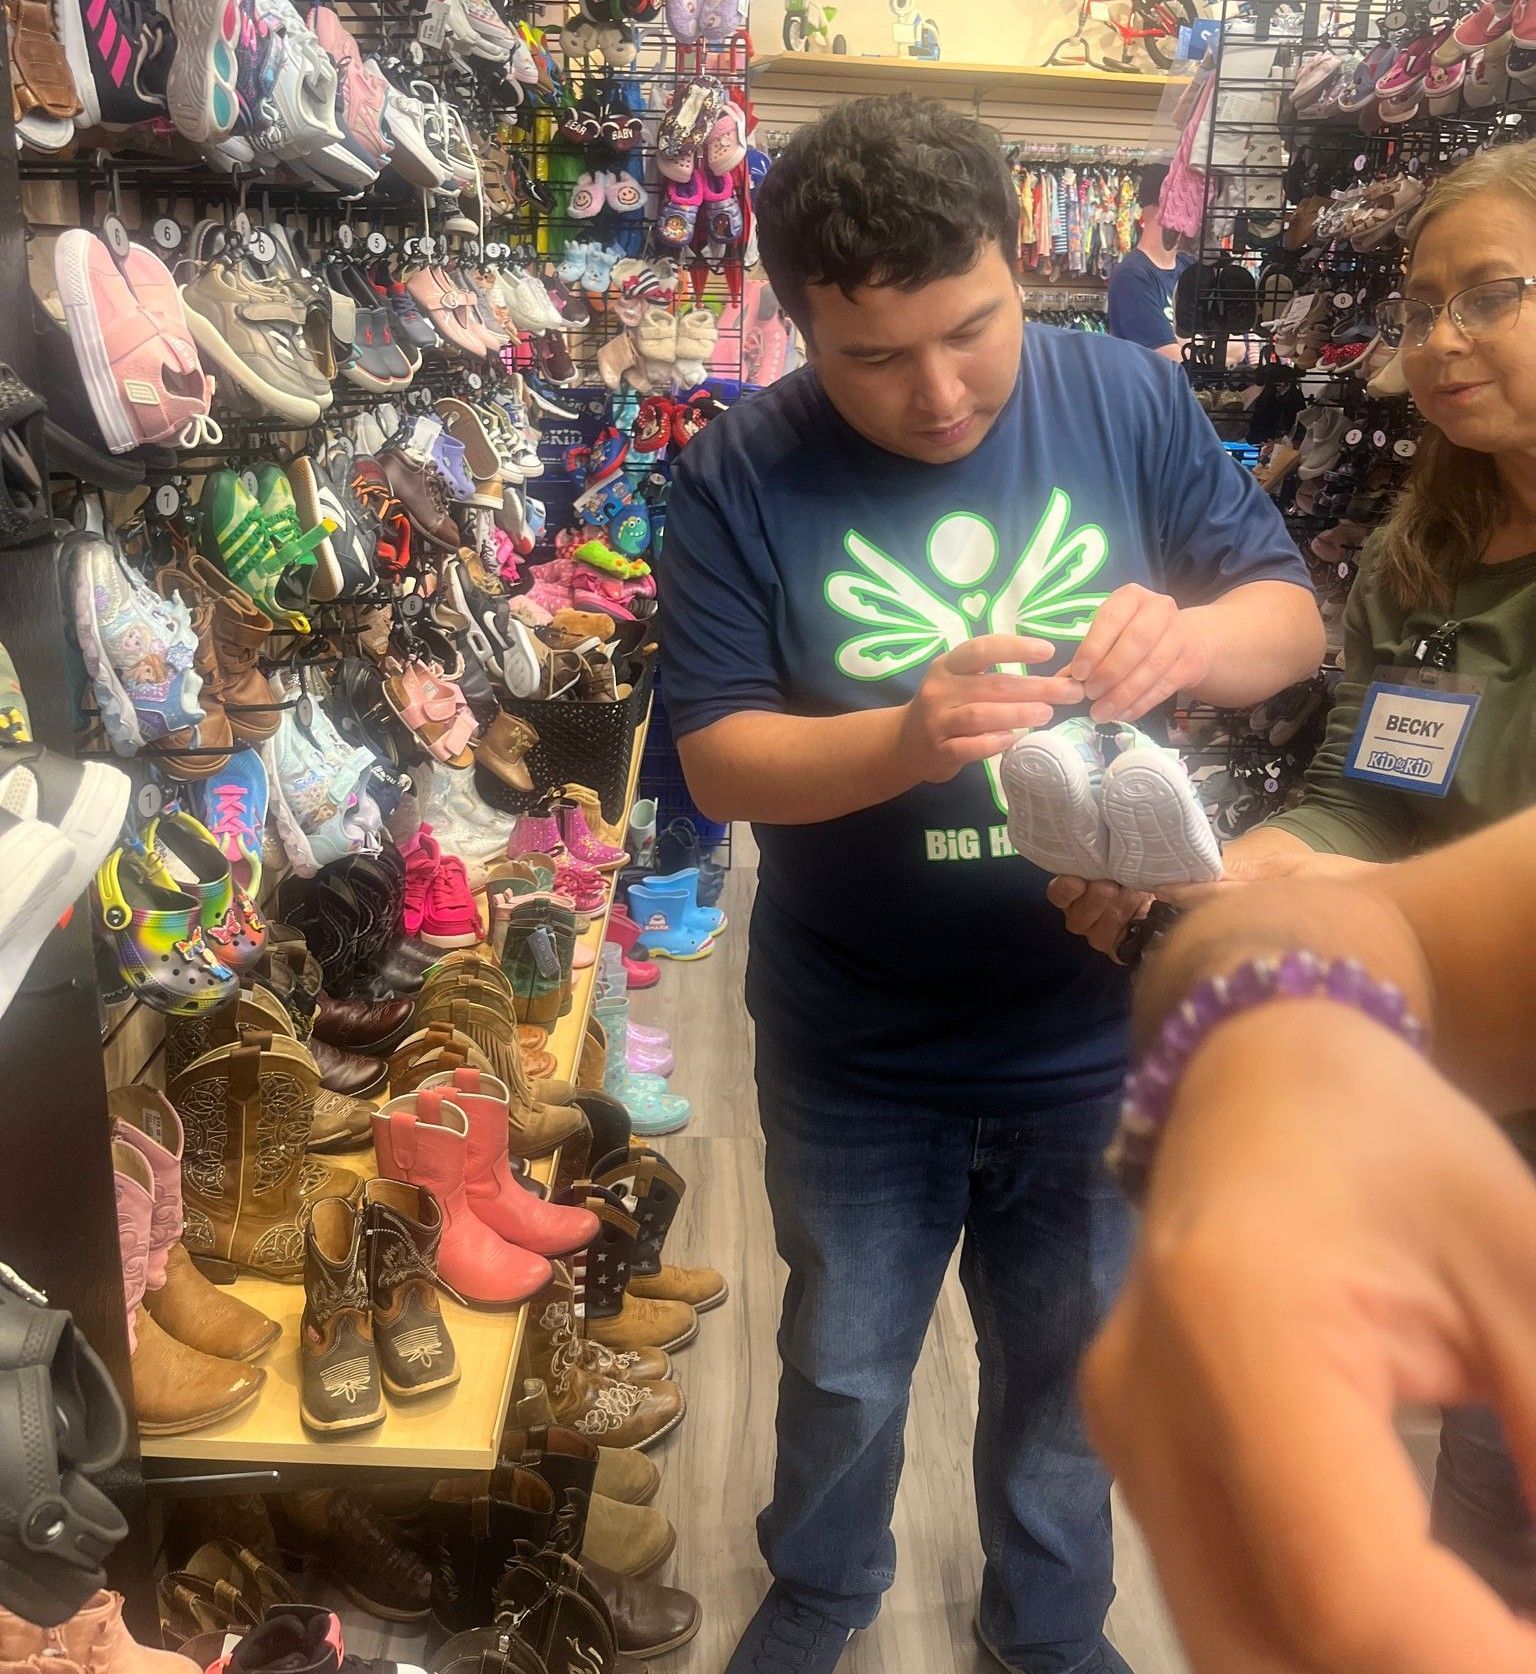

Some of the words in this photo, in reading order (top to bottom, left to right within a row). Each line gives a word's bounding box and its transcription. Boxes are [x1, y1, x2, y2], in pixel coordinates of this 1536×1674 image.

[611, 127, 633, 141] BABY
[114, 228, 121, 247] 6
[163, 226, 171, 241] 6
[258, 239, 266, 254] 6
[374, 237, 380, 249] 5
[1340, 296, 1346, 305] 0
[550, 428, 583, 445] KiD
[1401, 443, 1409, 453] 2
[163, 492, 170, 509] 7
[1385, 714, 1444, 738] BECKY
[988, 824, 1020, 858] H
